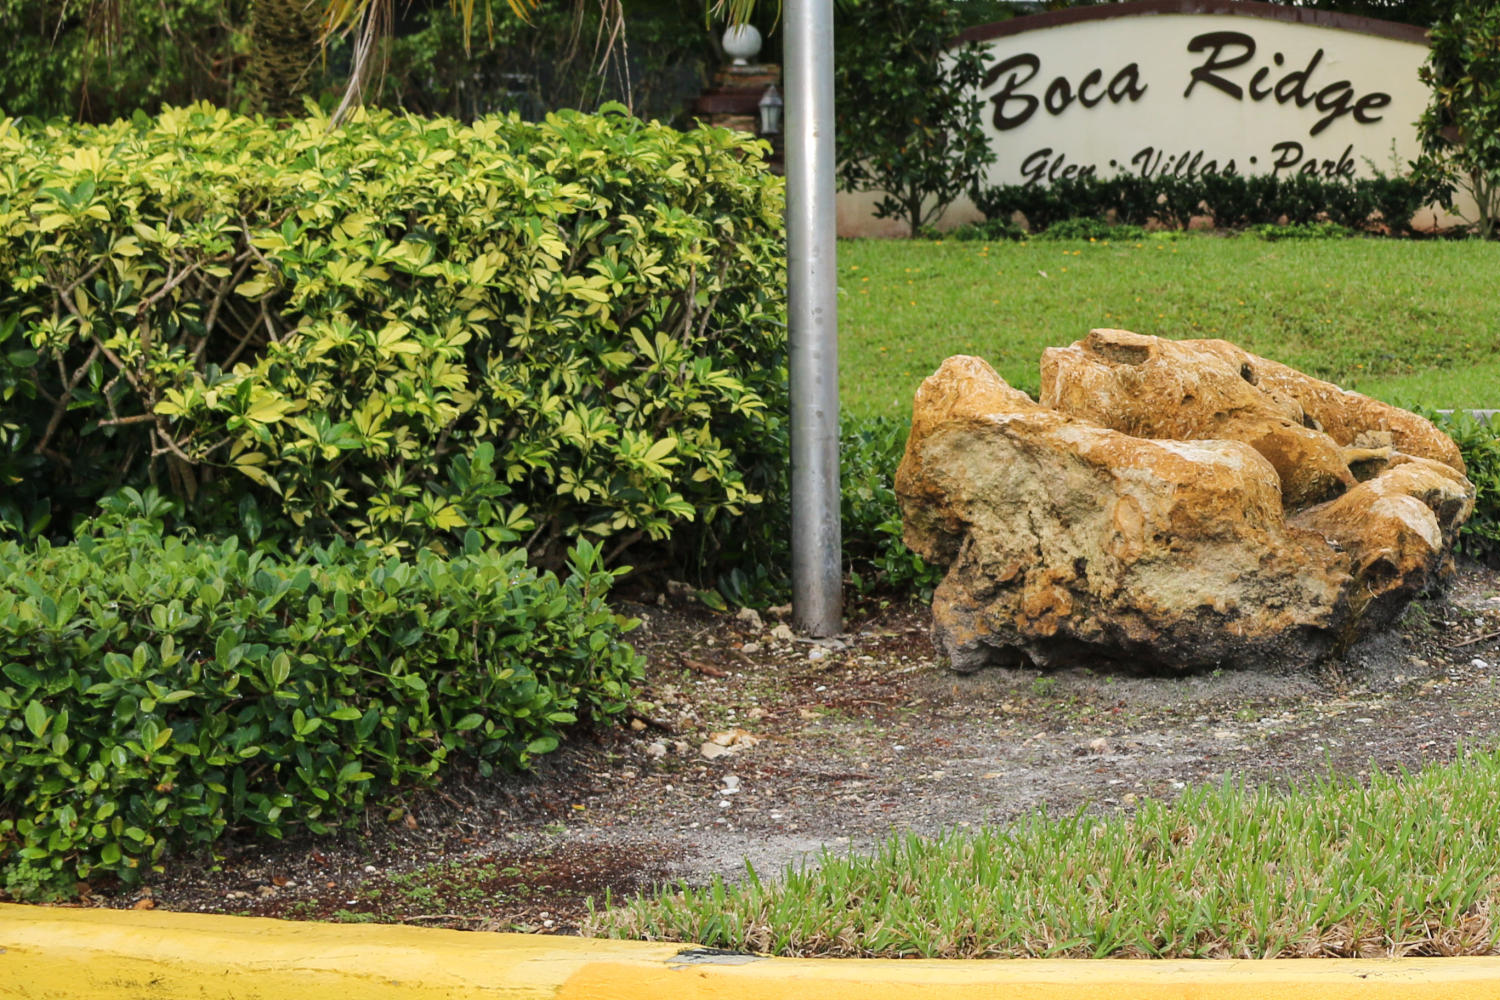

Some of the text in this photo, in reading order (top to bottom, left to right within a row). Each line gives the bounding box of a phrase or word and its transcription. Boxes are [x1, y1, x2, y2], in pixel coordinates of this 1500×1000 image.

[980, 31, 1391, 136] Boca Ridge
[1020, 141, 1355, 187] Glen Villas Park
